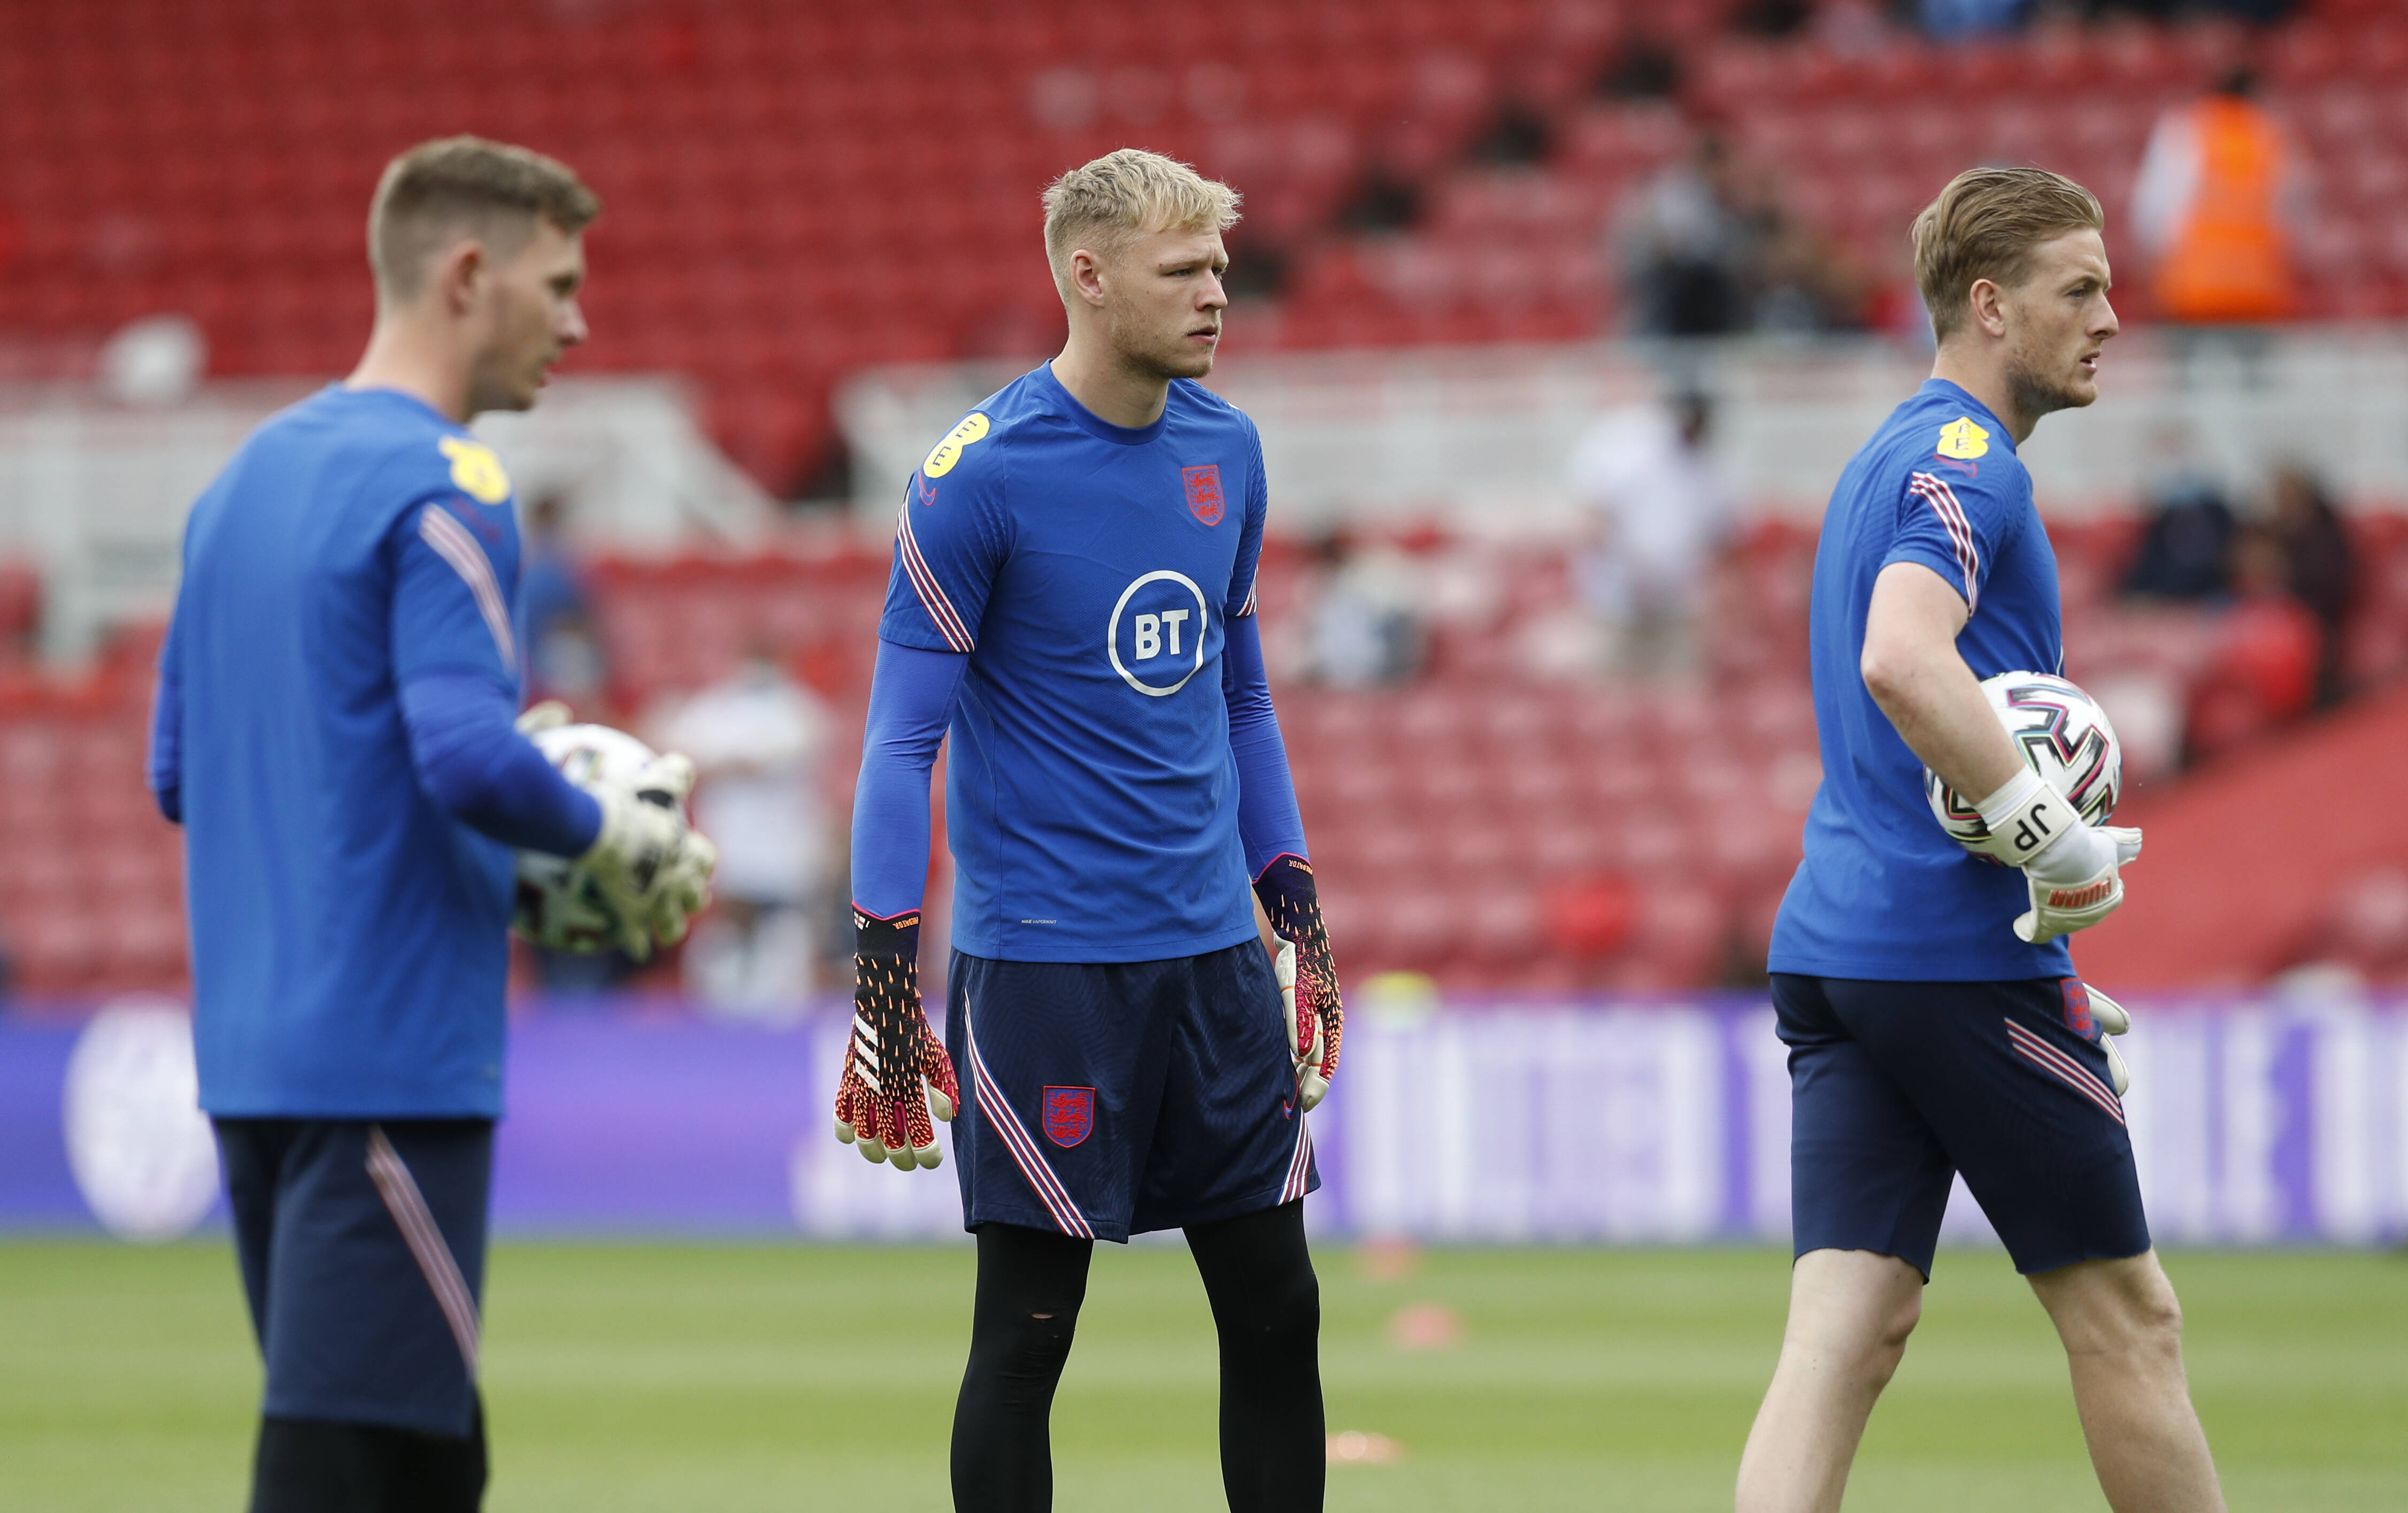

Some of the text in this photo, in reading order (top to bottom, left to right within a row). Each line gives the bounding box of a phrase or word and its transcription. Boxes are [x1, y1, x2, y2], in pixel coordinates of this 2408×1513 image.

[1135, 609, 1189, 660] BT
[2013, 803, 2051, 851] JP
[1289, 859, 1313, 875] PREDATOR
